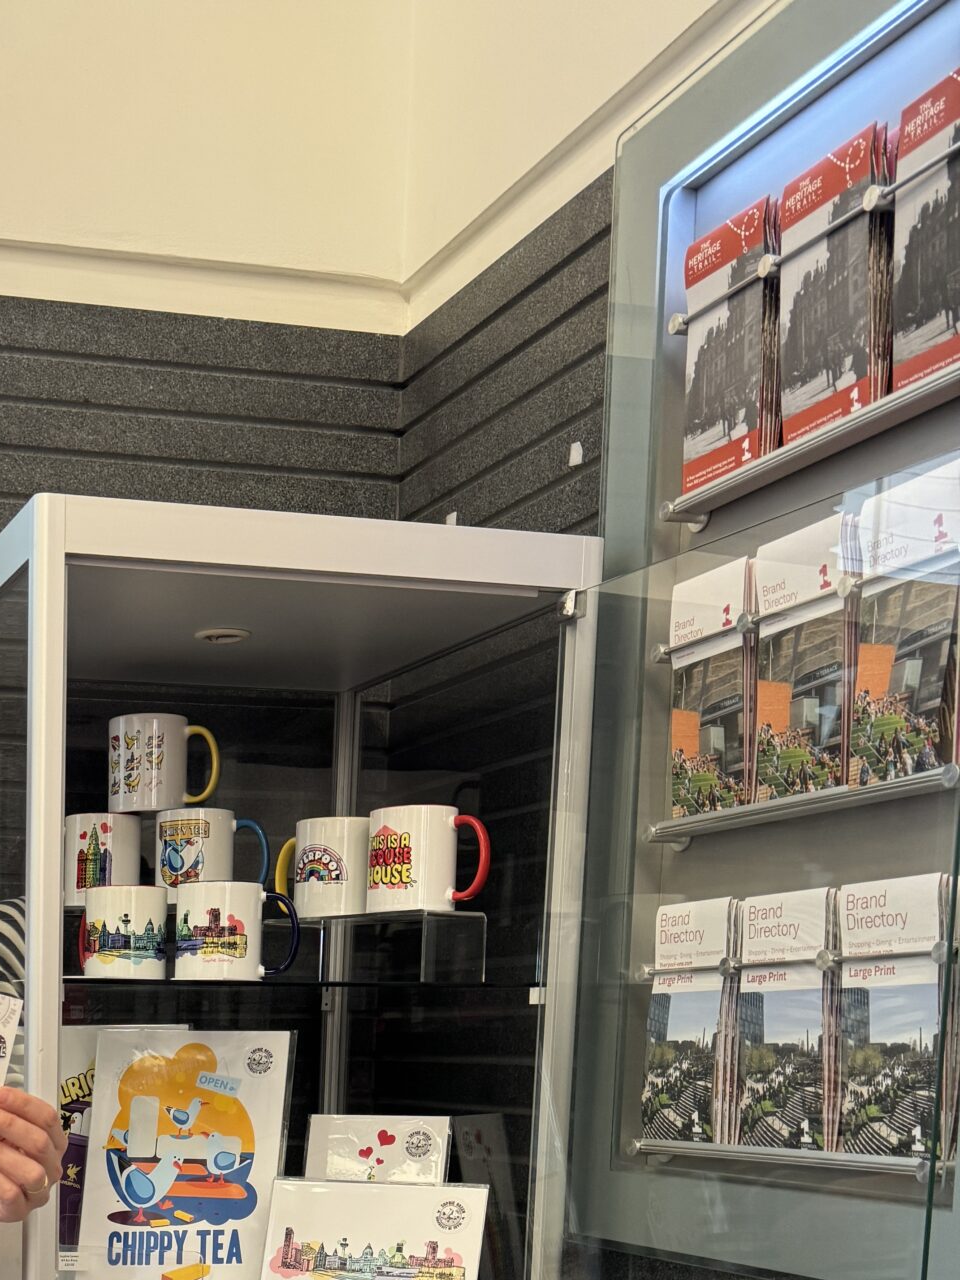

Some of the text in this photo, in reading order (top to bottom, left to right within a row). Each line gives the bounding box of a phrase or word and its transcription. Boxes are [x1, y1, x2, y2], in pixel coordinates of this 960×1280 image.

[920, 98, 932, 113] THE
[905, 97, 946, 136] HERITAGE
[911, 114, 938, 139] TRAIL
[786, 175, 823, 210] HERITAGE
[800, 176, 811, 190] THE
[792, 192, 816, 213] TRAIL
[688, 239, 722, 269] HERITAGE
[701, 239, 711, 251] THE
[693, 254, 717, 273] TRAIL
[869, 543, 910, 569] Directory
[762, 578, 786, 598] Brand
[763, 591, 800, 611] Directory
[674, 616, 695, 633] Brand
[674, 627, 704, 645] Directory
[387, 833, 399, 849] IS
[400, 831, 411, 848] A
[845, 888, 887, 911] Brand
[660, 909, 691, 928] Brand
[748, 901, 783, 922] Brand
[846, 911, 908, 931] Directory
[660, 928, 705, 945] Directory
[748, 921, 800, 940] Directory
[658, 973, 693, 987] Large Print
[746, 970, 787, 985] Large Print
[848, 964, 896, 980] Large Print
[198, 1074, 230, 1091] OPEN
[107, 1228, 243, 1267] CHIPPY TEA
